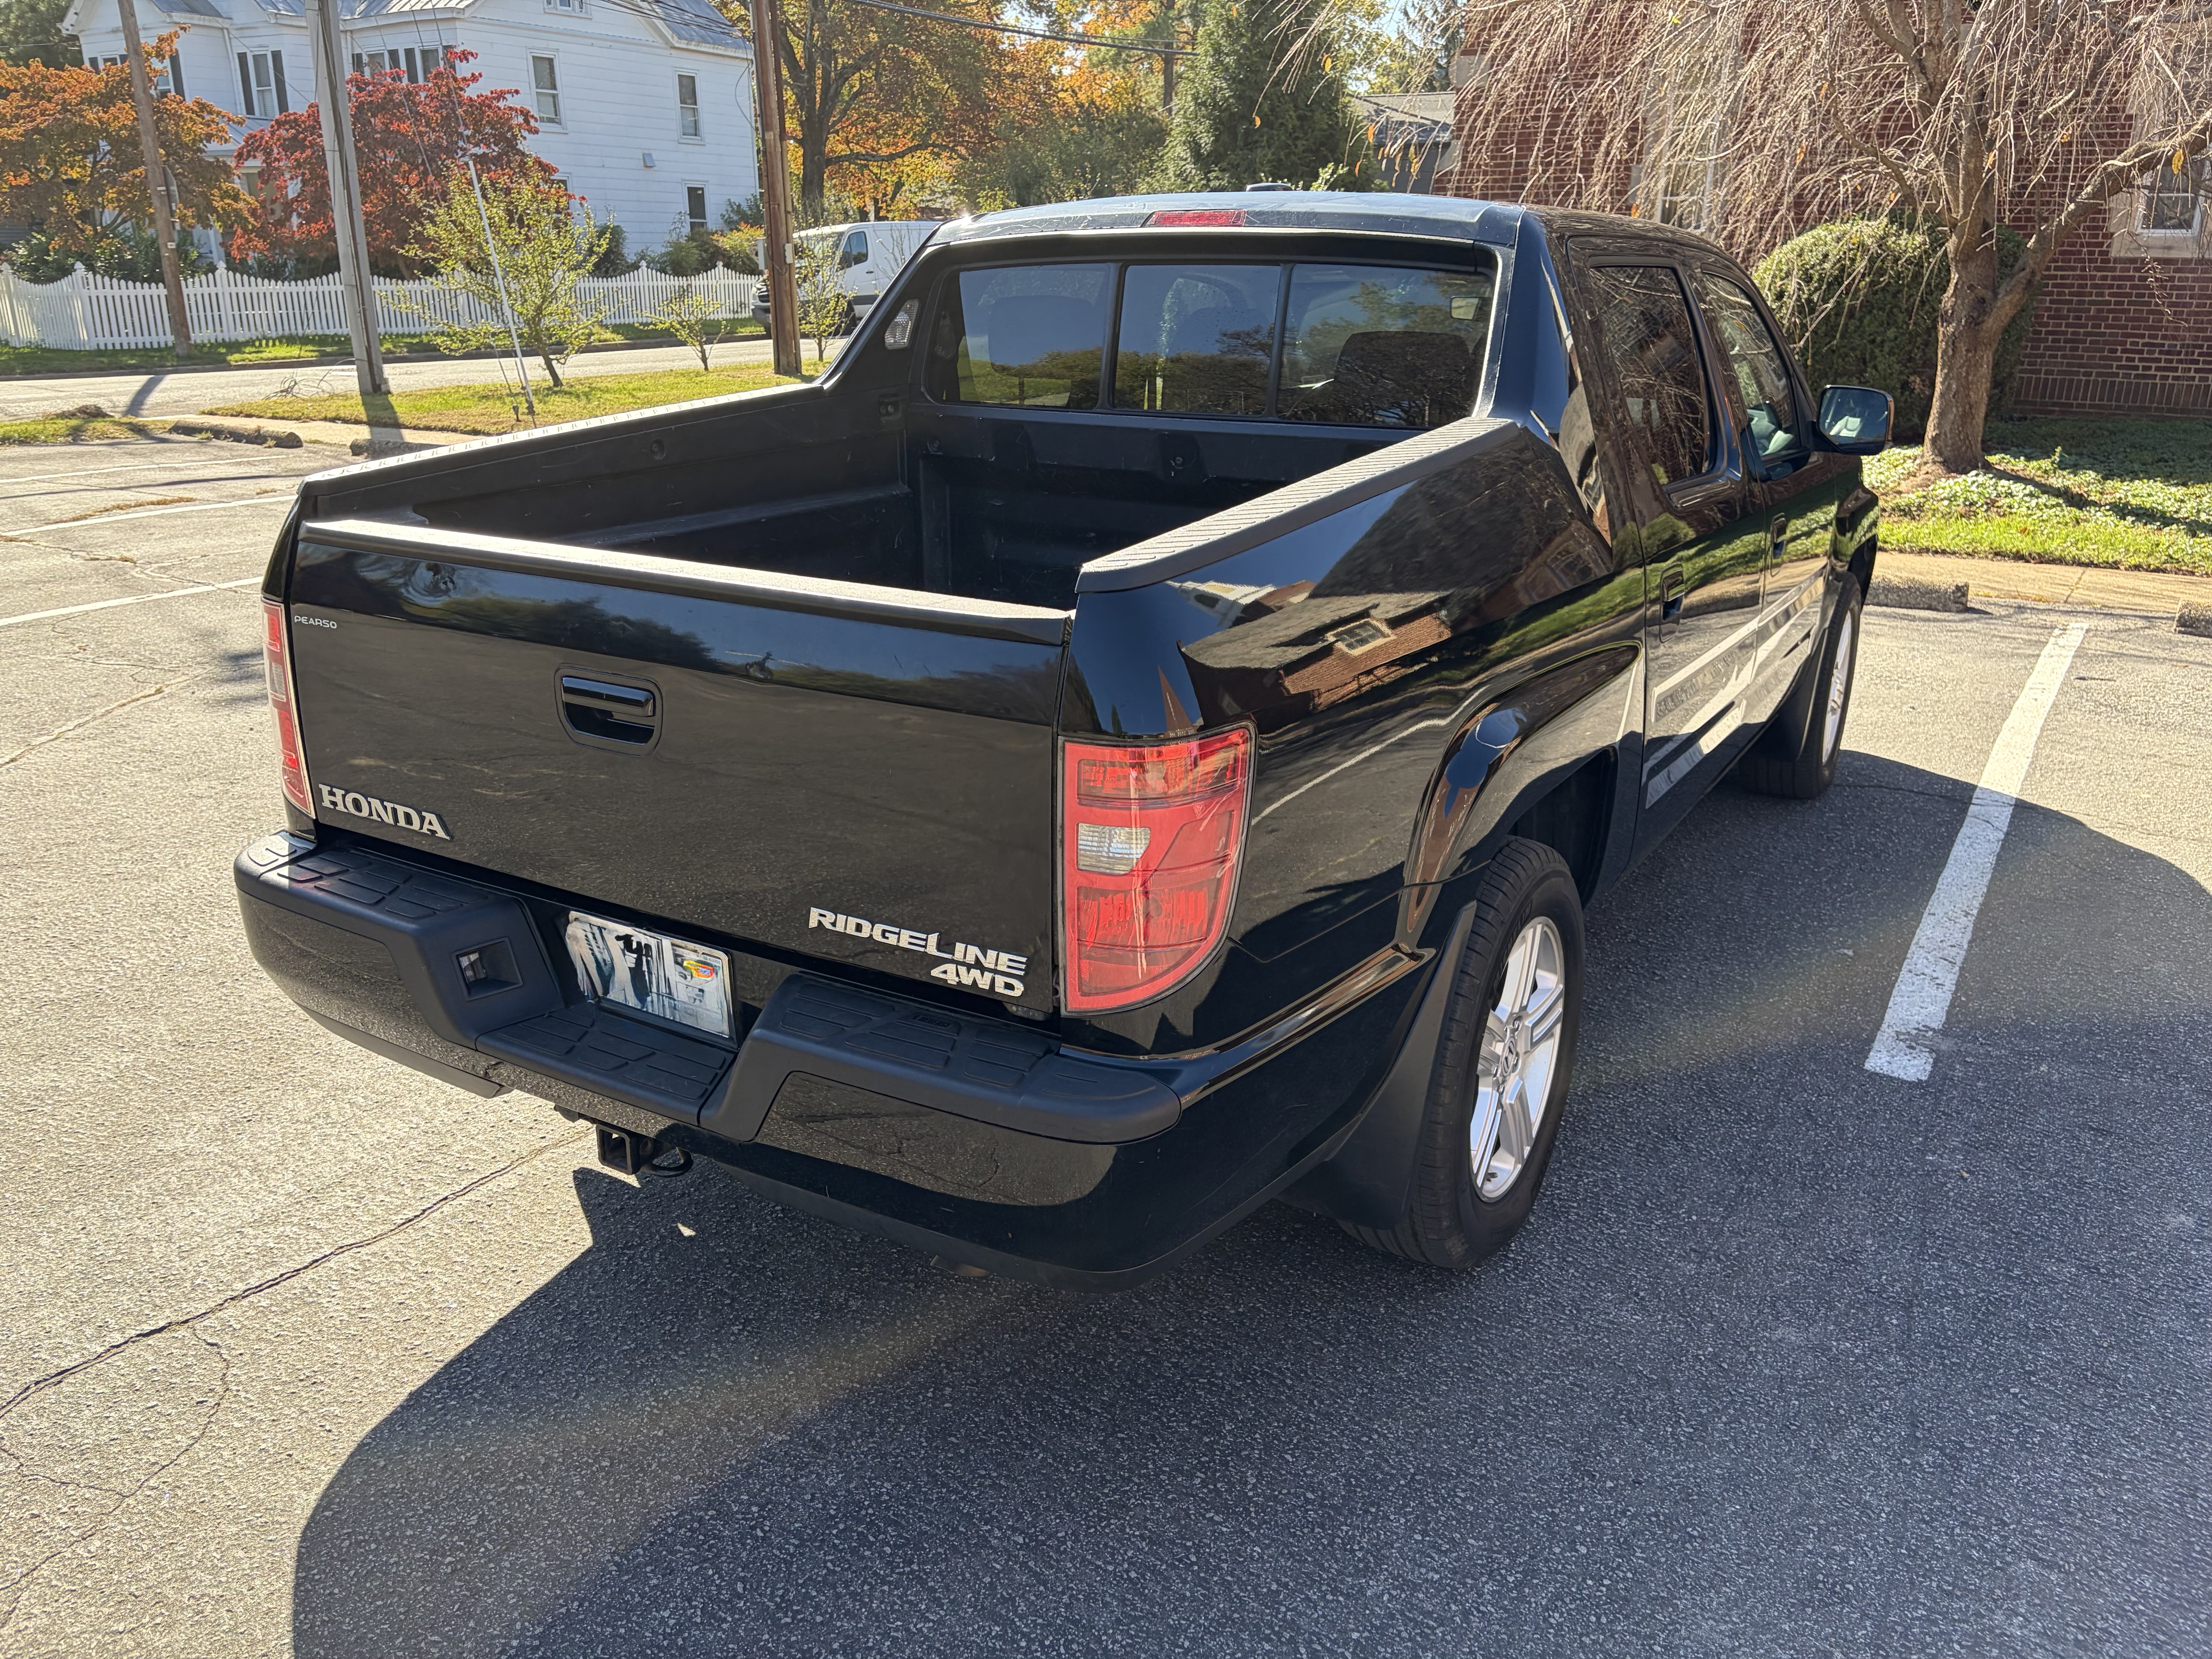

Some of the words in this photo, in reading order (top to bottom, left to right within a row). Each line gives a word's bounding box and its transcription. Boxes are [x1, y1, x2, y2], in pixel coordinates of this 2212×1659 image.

[294, 615, 337, 629] PEARSO
[318, 784, 451, 840] HONDA
[809, 907, 1028, 975] RIDGELINE
[931, 963, 1024, 997] 4WD
